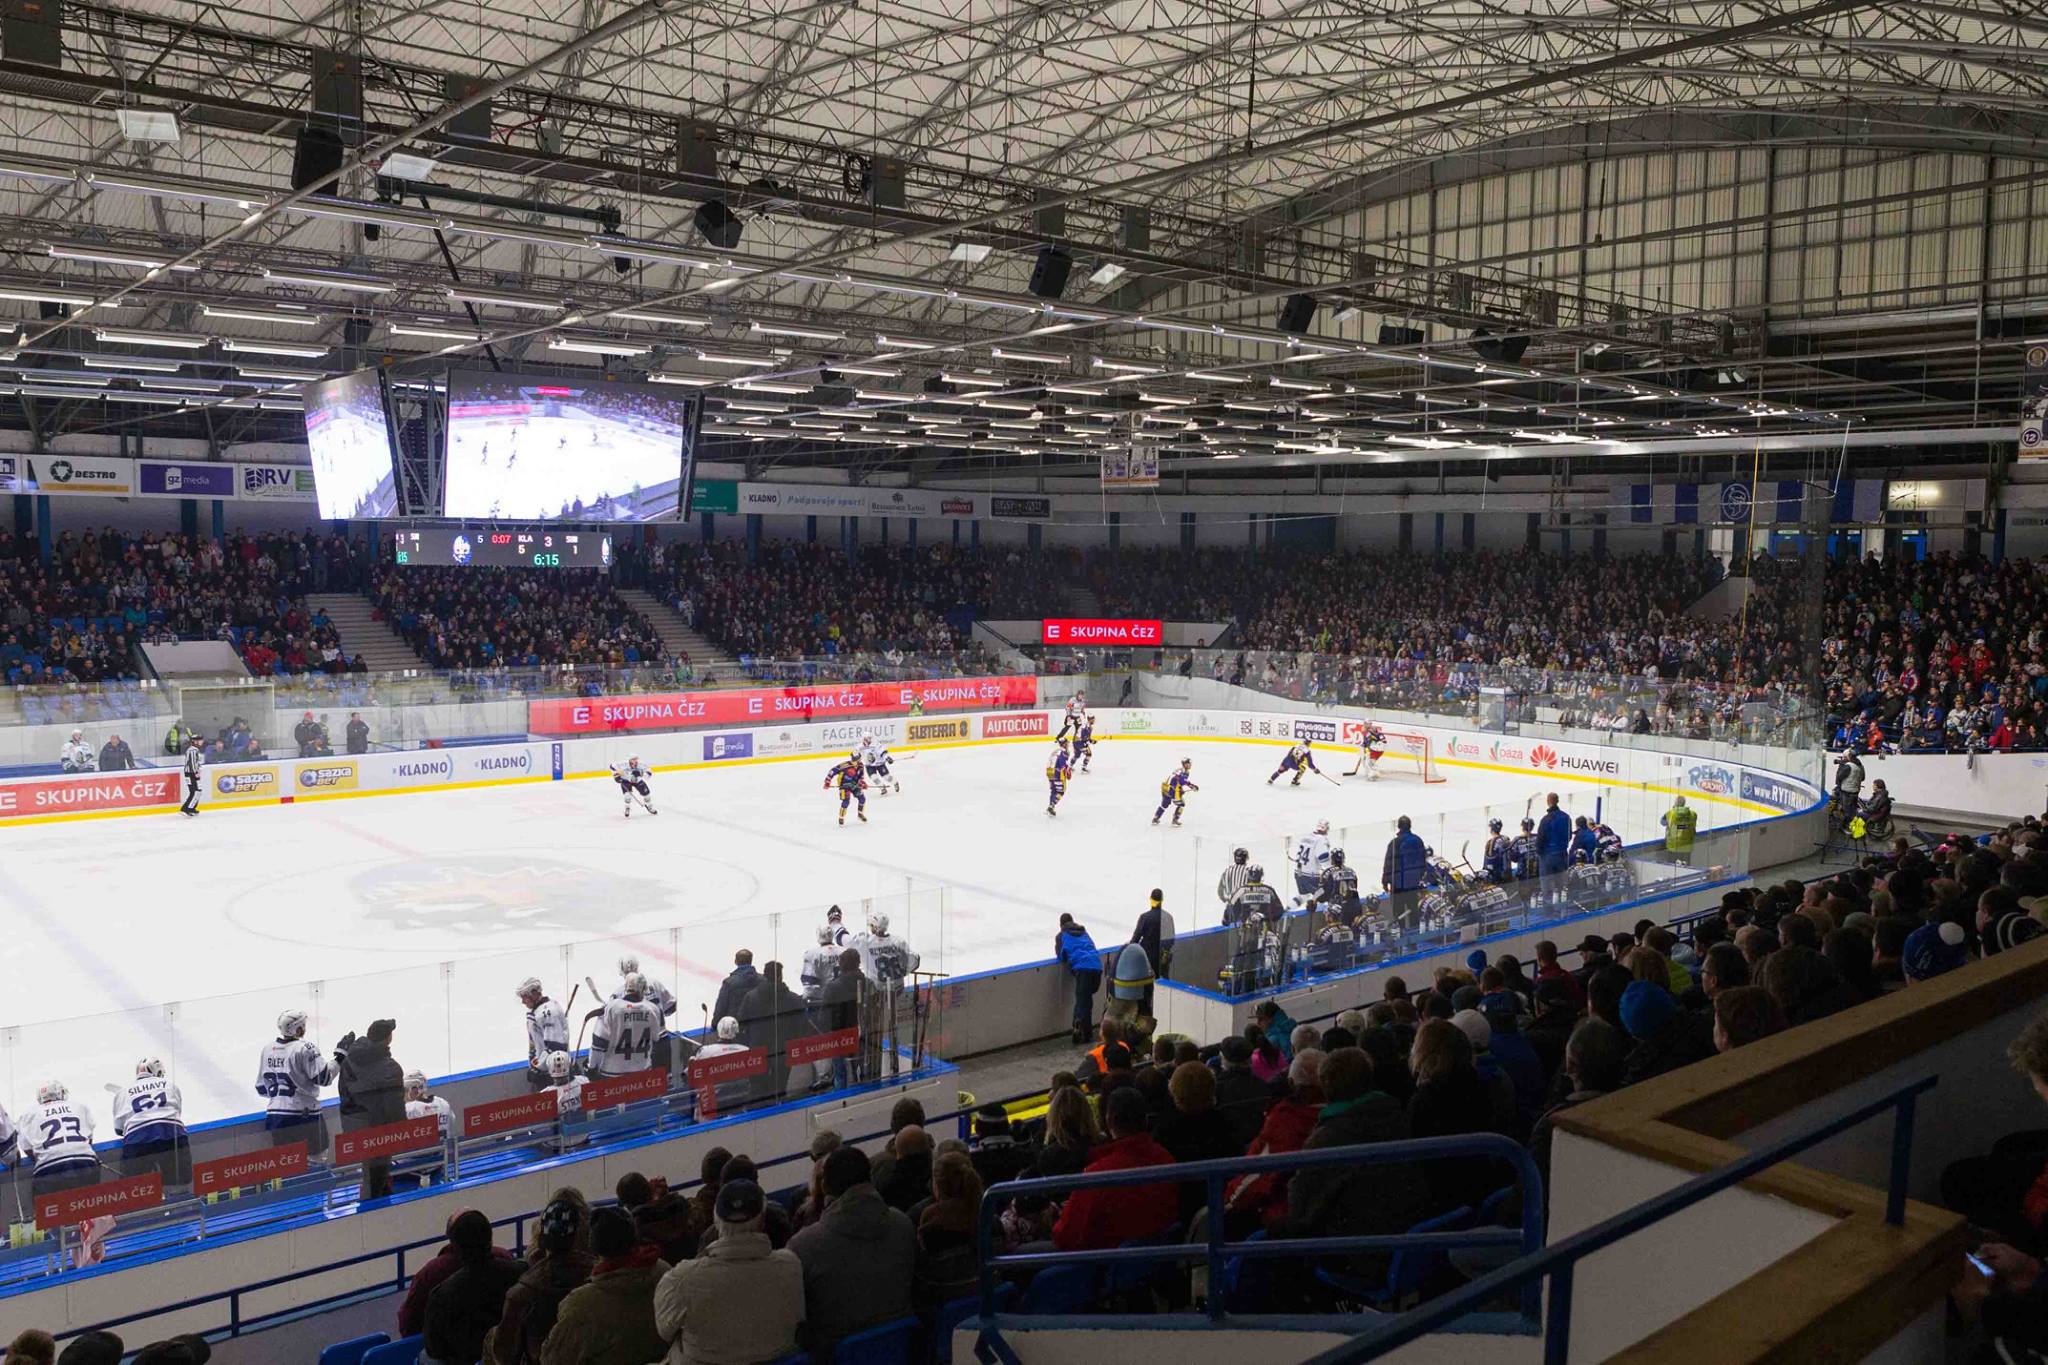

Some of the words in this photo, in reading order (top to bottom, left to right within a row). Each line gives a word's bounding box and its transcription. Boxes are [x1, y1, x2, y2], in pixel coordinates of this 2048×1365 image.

[2025, 433, 2037, 442] 12
[74, 471, 116, 479] DESTRO
[167, 475, 180, 485] gz
[183, 475, 210, 485] media
[749, 494, 777, 503] KLADNO
[477, 535, 484, 543] 5
[491, 535, 511, 544] 0:07
[518, 535, 533, 543] KLA
[544, 536, 552, 547] 3
[518, 545, 526, 554] 5
[572, 546, 578, 554] 1
[534, 554, 559, 565] 6:15
[1071, 626, 1127, 638] SKUPINA
[1131, 624, 1155, 638] ČEZ
[923, 688, 976, 701] SKUPINA
[979, 680, 1001, 698] ČEZ
[775, 696, 836, 711] SKUPINA
[840, 690, 864, 707] ČEZ
[604, 704, 673, 720] SKUPINA
[678, 699, 705, 716] ČEZ
[987, 718, 1044, 733] AUTOCONT
[1456, 744, 1480, 754] oaza
[1500, 748, 1523, 759] oaza
[399, 761, 448, 776] KLADNO
[481, 756, 527, 770] KLADNO
[1561, 756, 1619, 773] HUAWEI
[1688, 765, 1734, 793] RELAX
[36, 785, 125, 805] SKUPINA
[131, 780, 166, 798] ČEZ
[624, 1012, 649, 1022] PITULE
[615, 1028, 650, 1060] 44
[805, 1041, 839, 1054] SKUPINA
[841, 1037, 855, 1047] ČEZ
[709, 1061, 746, 1075] SKUPINA
[747, 1056, 762, 1067] ČEZ
[262, 1072, 299, 1097] 83
[603, 1082, 643, 1097] SKUPINA
[645, 1077, 663, 1088] ČEZ
[131, 1091, 167, 1114] 61
[489, 1105, 533, 1122] SKUPINA
[535, 1100, 552, 1112] ČEZ
[40, 1116, 88, 1149] 23
[362, 1131, 410, 1149] SKUPINA
[413, 1126, 432, 1138] ČEZ
[223, 1159, 276, 1178] SKUPINA
[279, 1153, 300, 1166] ČEZ
[69, 1191, 127, 1212] SKUPINA
[131, 1184, 155, 1198] ČEZ
